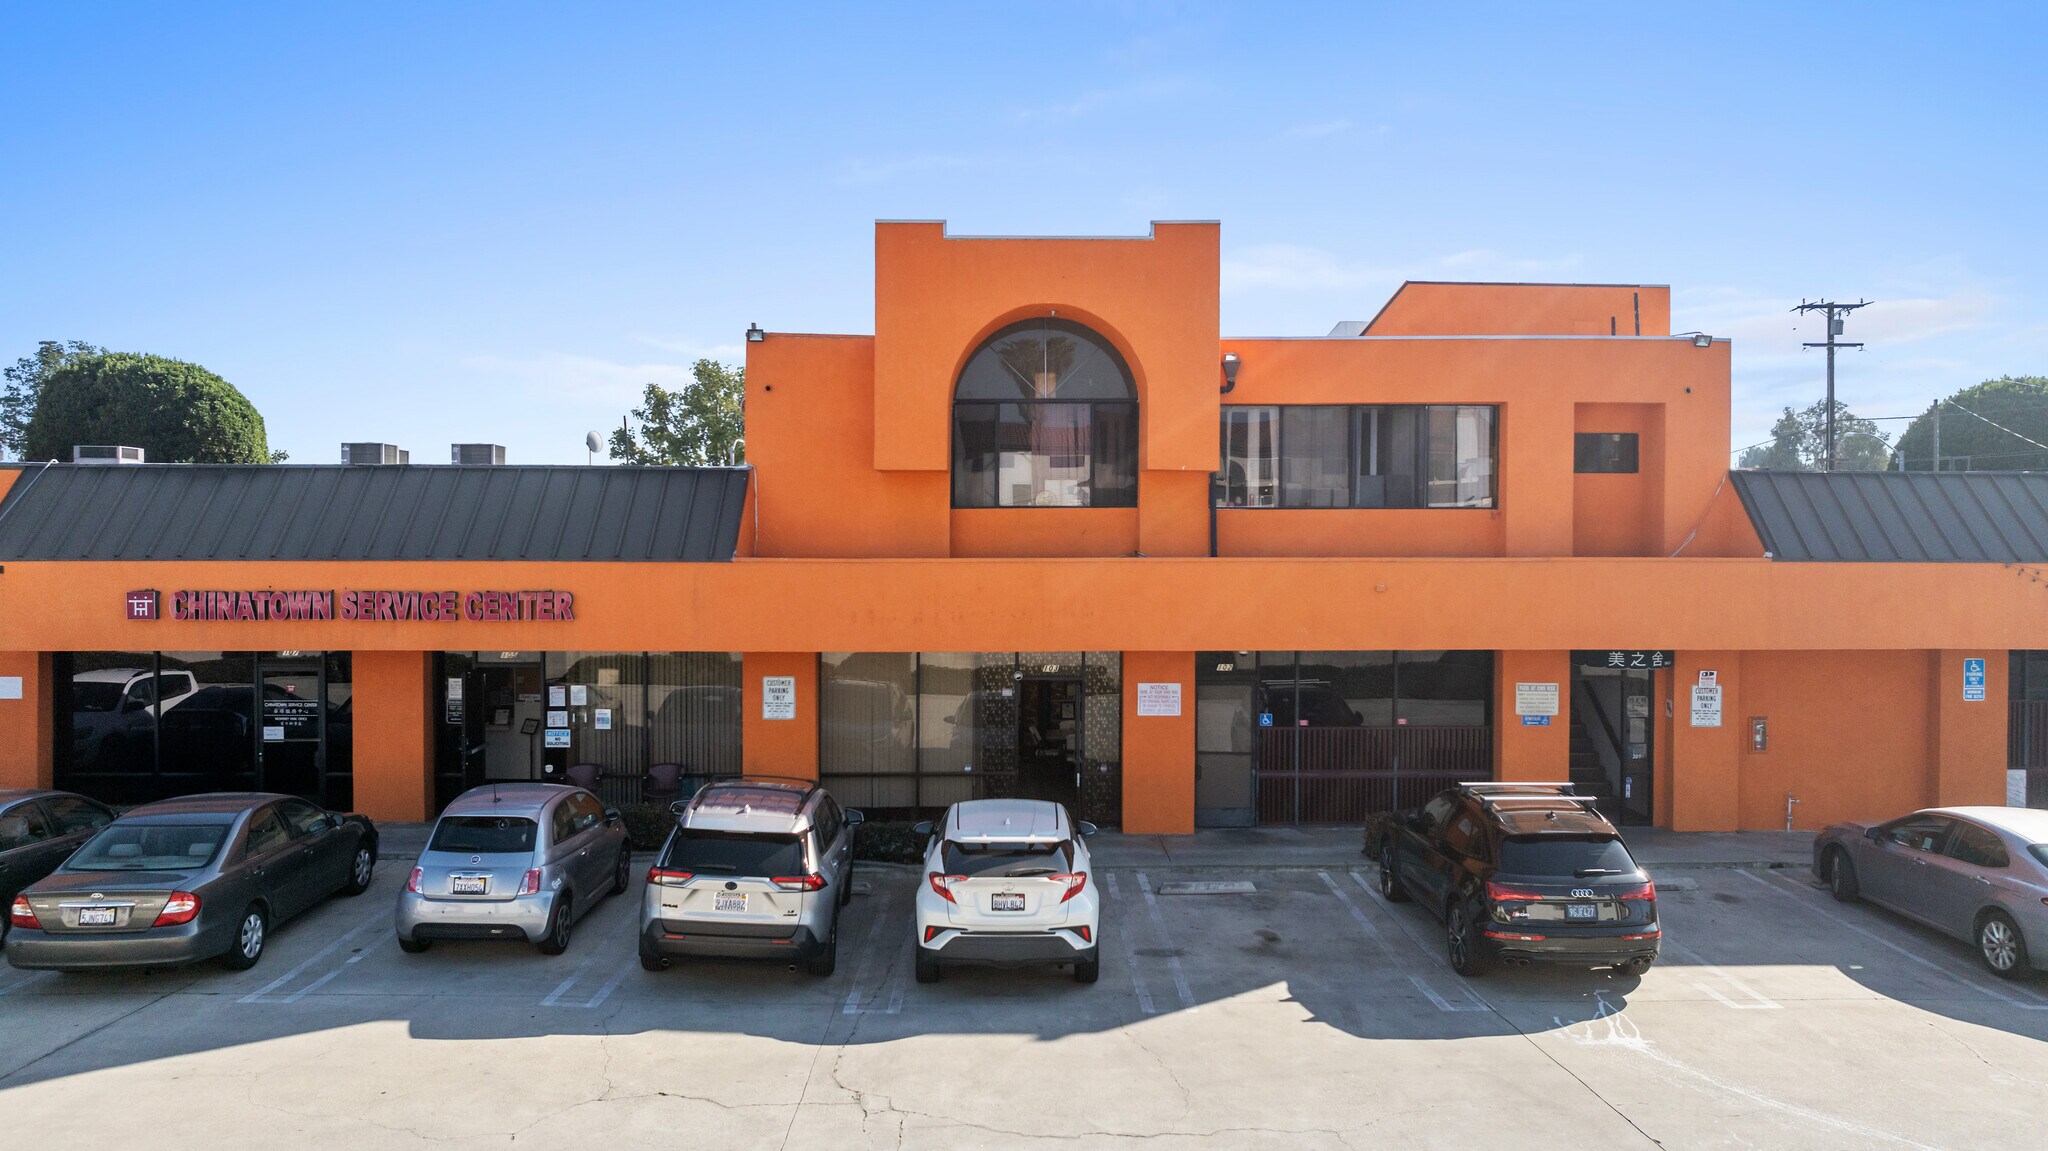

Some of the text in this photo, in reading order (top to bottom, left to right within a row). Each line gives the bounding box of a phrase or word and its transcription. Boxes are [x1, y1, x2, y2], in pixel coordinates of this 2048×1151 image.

[168, 590, 574, 621] CHINATOWN SERVICE CENTER
[1608, 651, 1664, 667] 美之舍
[1042, 664, 1060, 672] 103
[1216, 663, 1234, 671] 102
